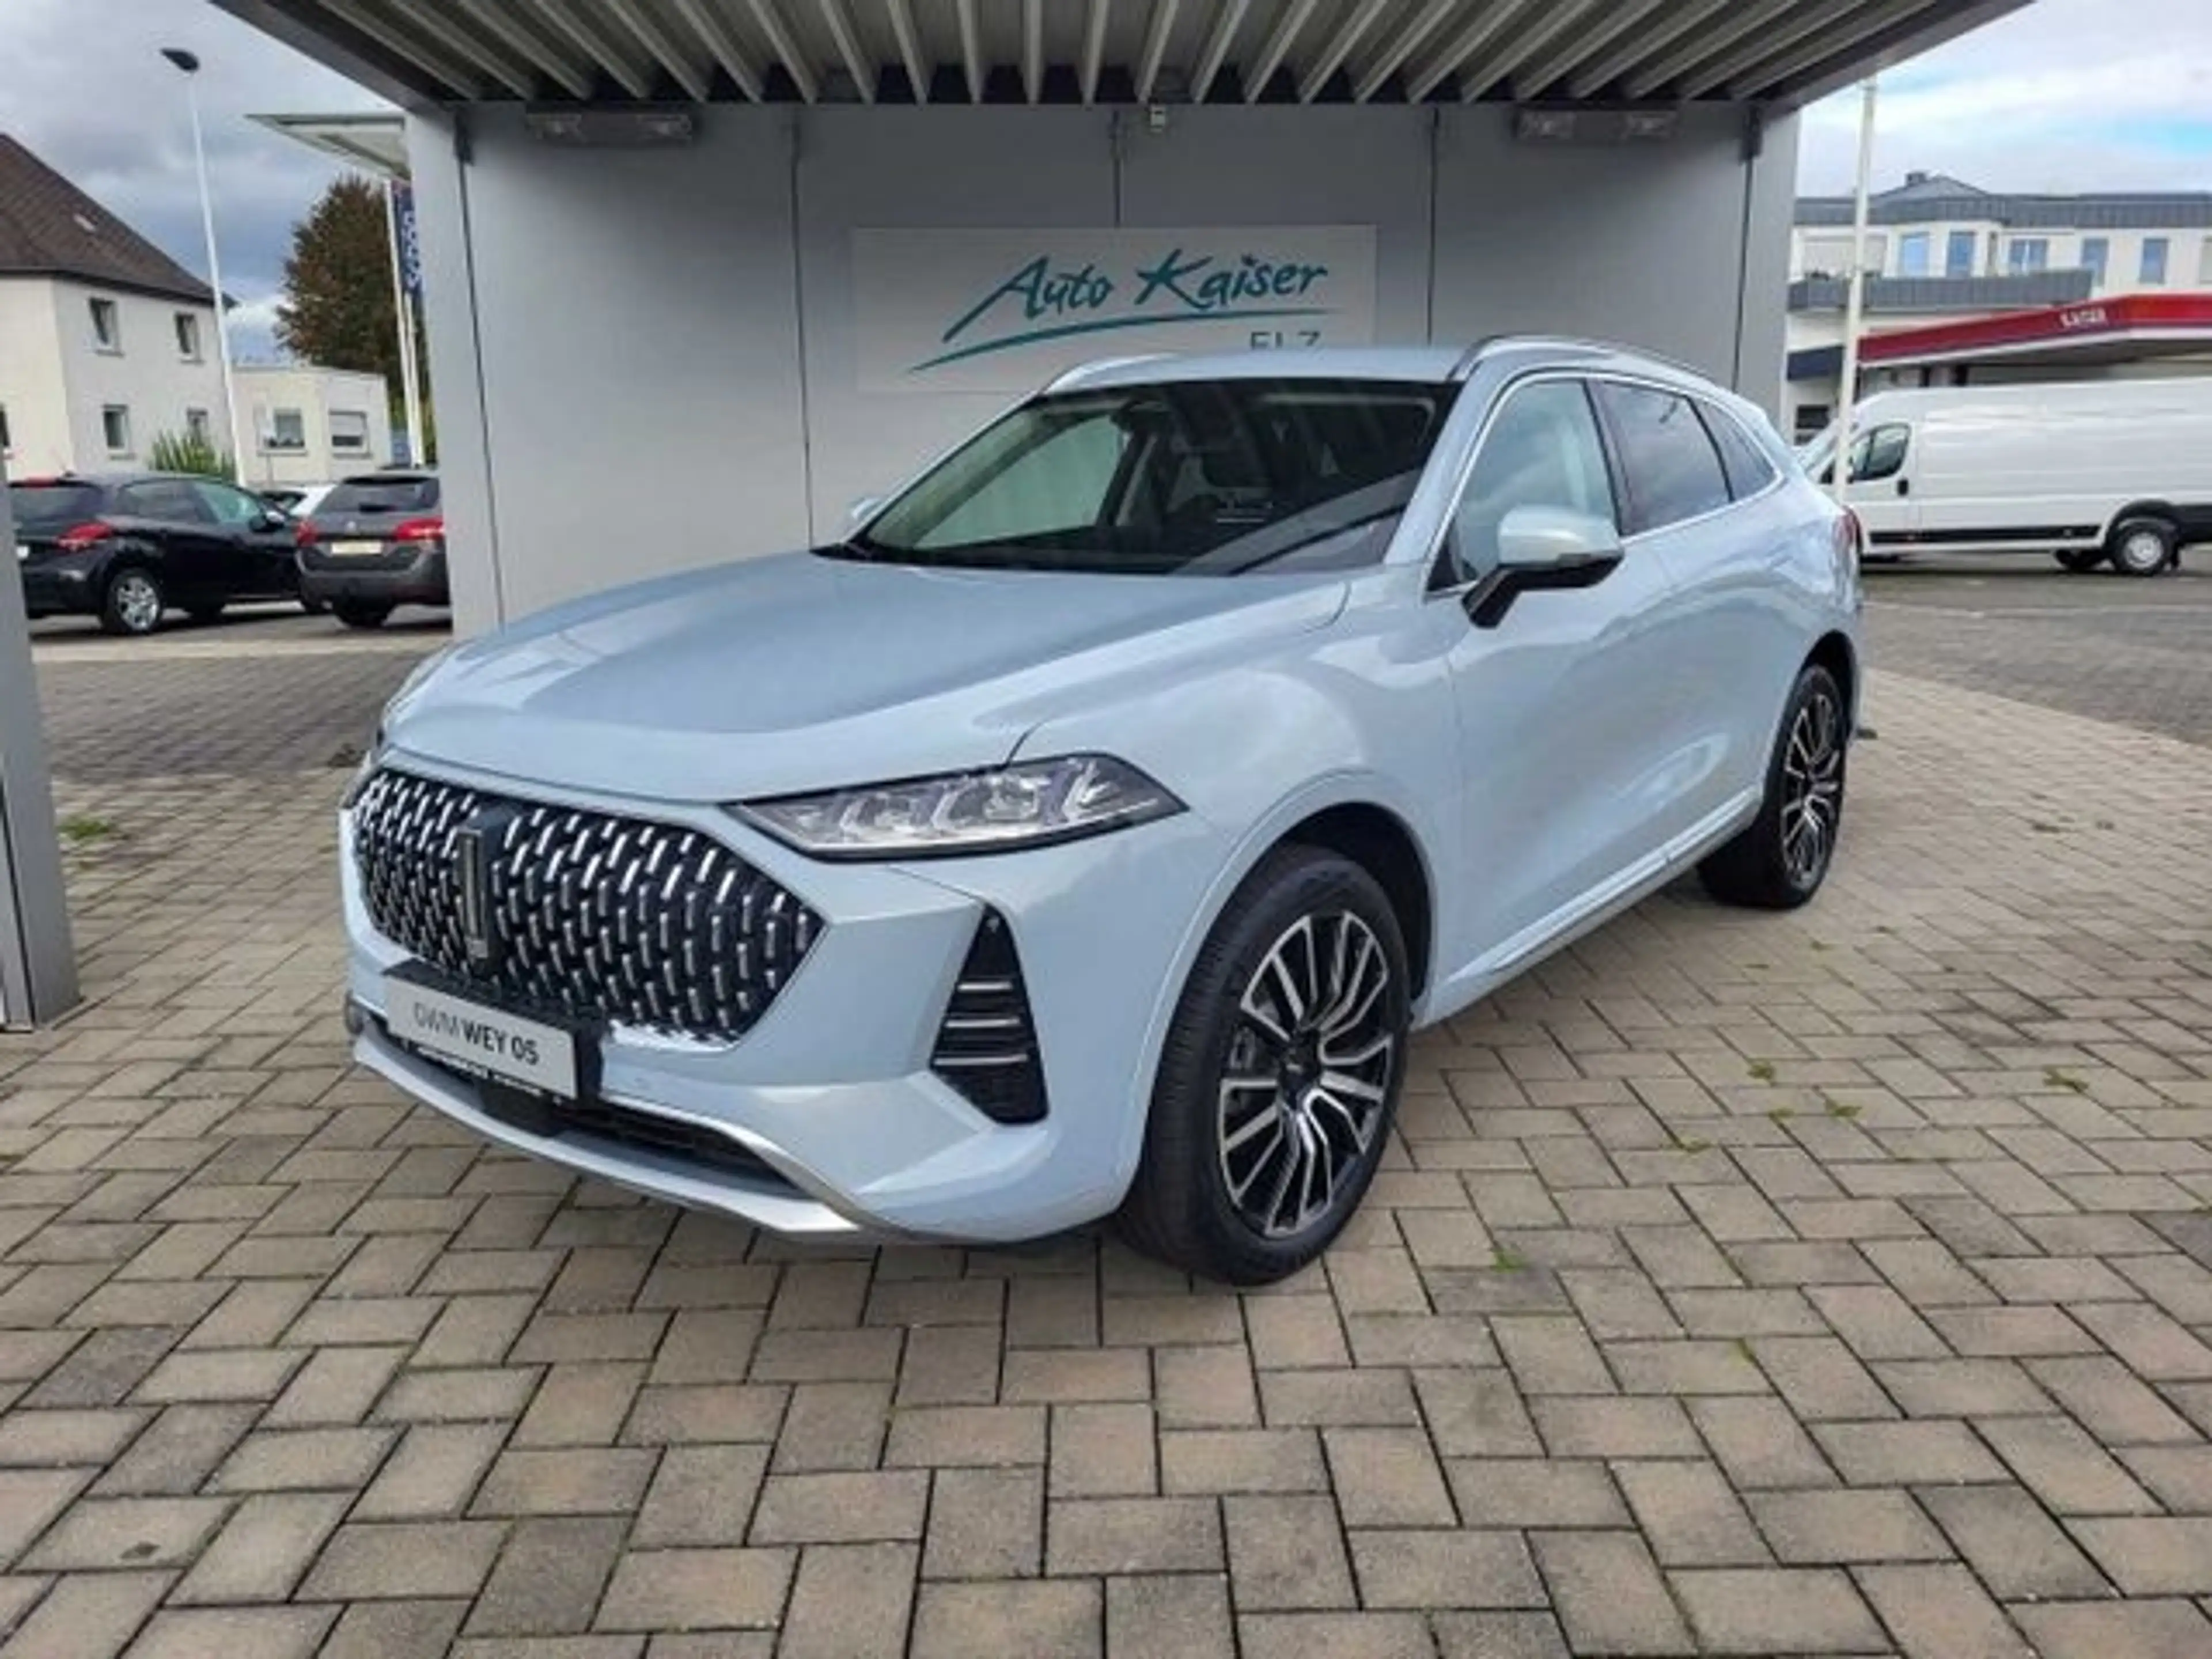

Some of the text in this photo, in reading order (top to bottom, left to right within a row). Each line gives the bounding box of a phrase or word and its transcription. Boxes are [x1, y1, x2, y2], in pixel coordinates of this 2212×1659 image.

[942, 248, 1329, 342] Auto Kaiser
[463, 1018, 508, 1055] WEY
[511, 1035, 540, 1066] 05
